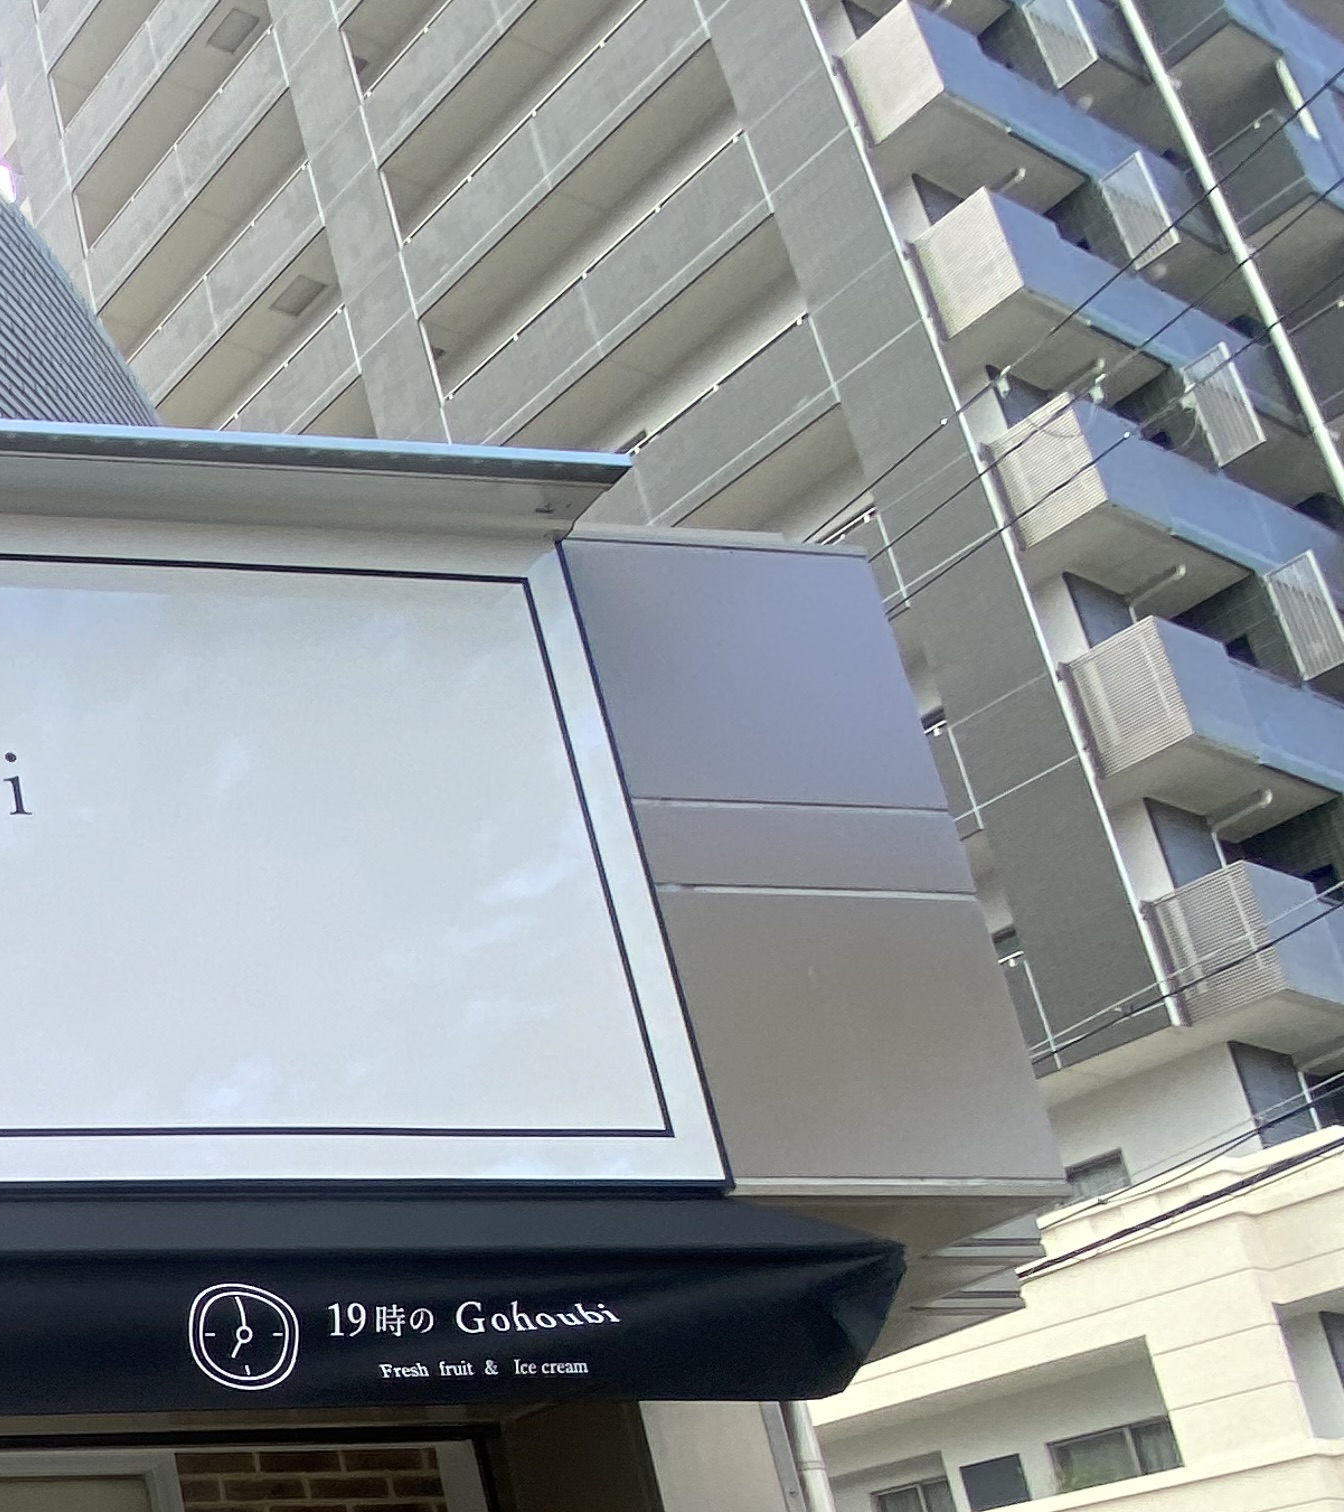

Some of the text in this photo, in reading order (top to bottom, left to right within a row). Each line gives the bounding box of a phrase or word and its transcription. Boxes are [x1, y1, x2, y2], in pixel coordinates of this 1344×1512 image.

[328, 1300, 621, 1338] 19時の Gohoubi
[378, 1359, 591, 1380] Fresh fruit & Ice cream
